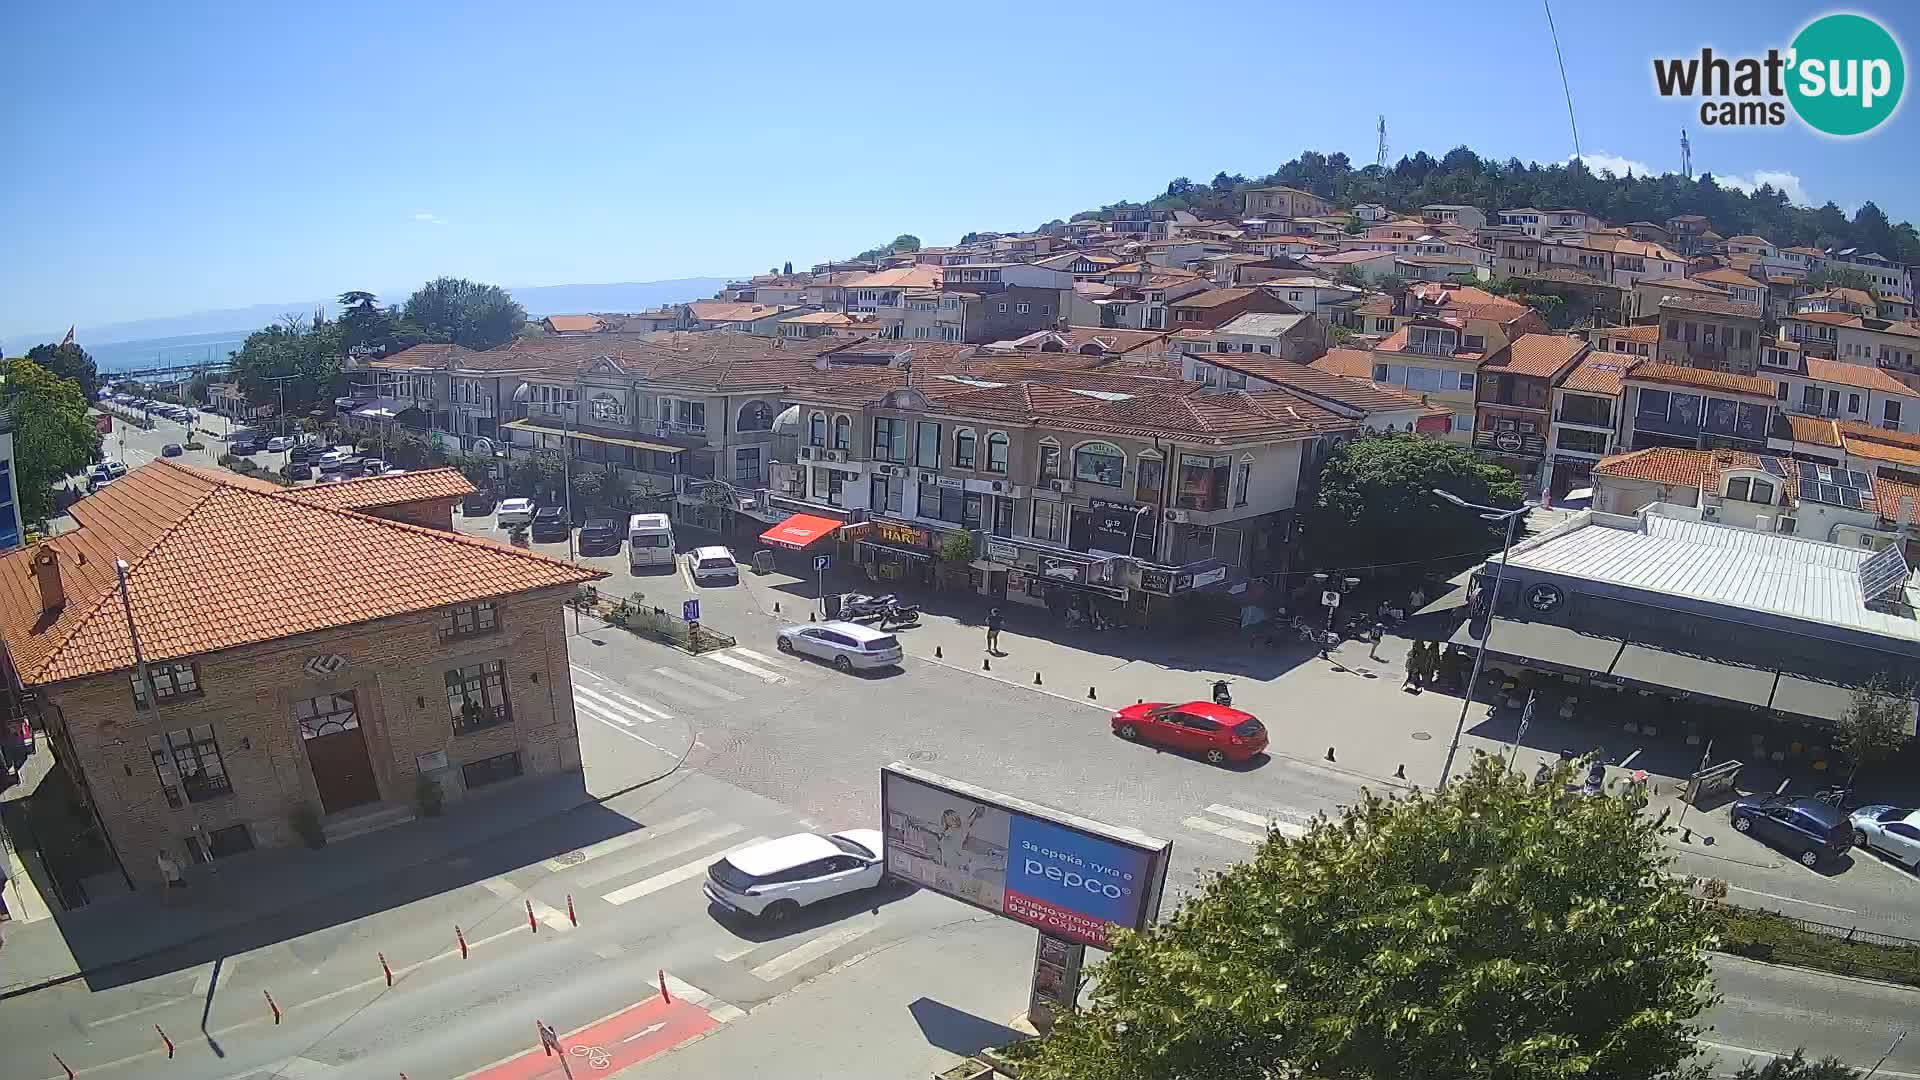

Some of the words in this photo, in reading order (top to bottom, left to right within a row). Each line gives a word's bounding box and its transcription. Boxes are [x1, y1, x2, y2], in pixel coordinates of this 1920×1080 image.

[818, 558, 826, 569] P
[1022, 840, 1038, 852] За
[1089, 862, 1120, 877] тука
[1123, 873, 1133, 881] е
[1009, 903, 1046, 921] 02.07
[1048, 916, 1096, 941] Охрид
